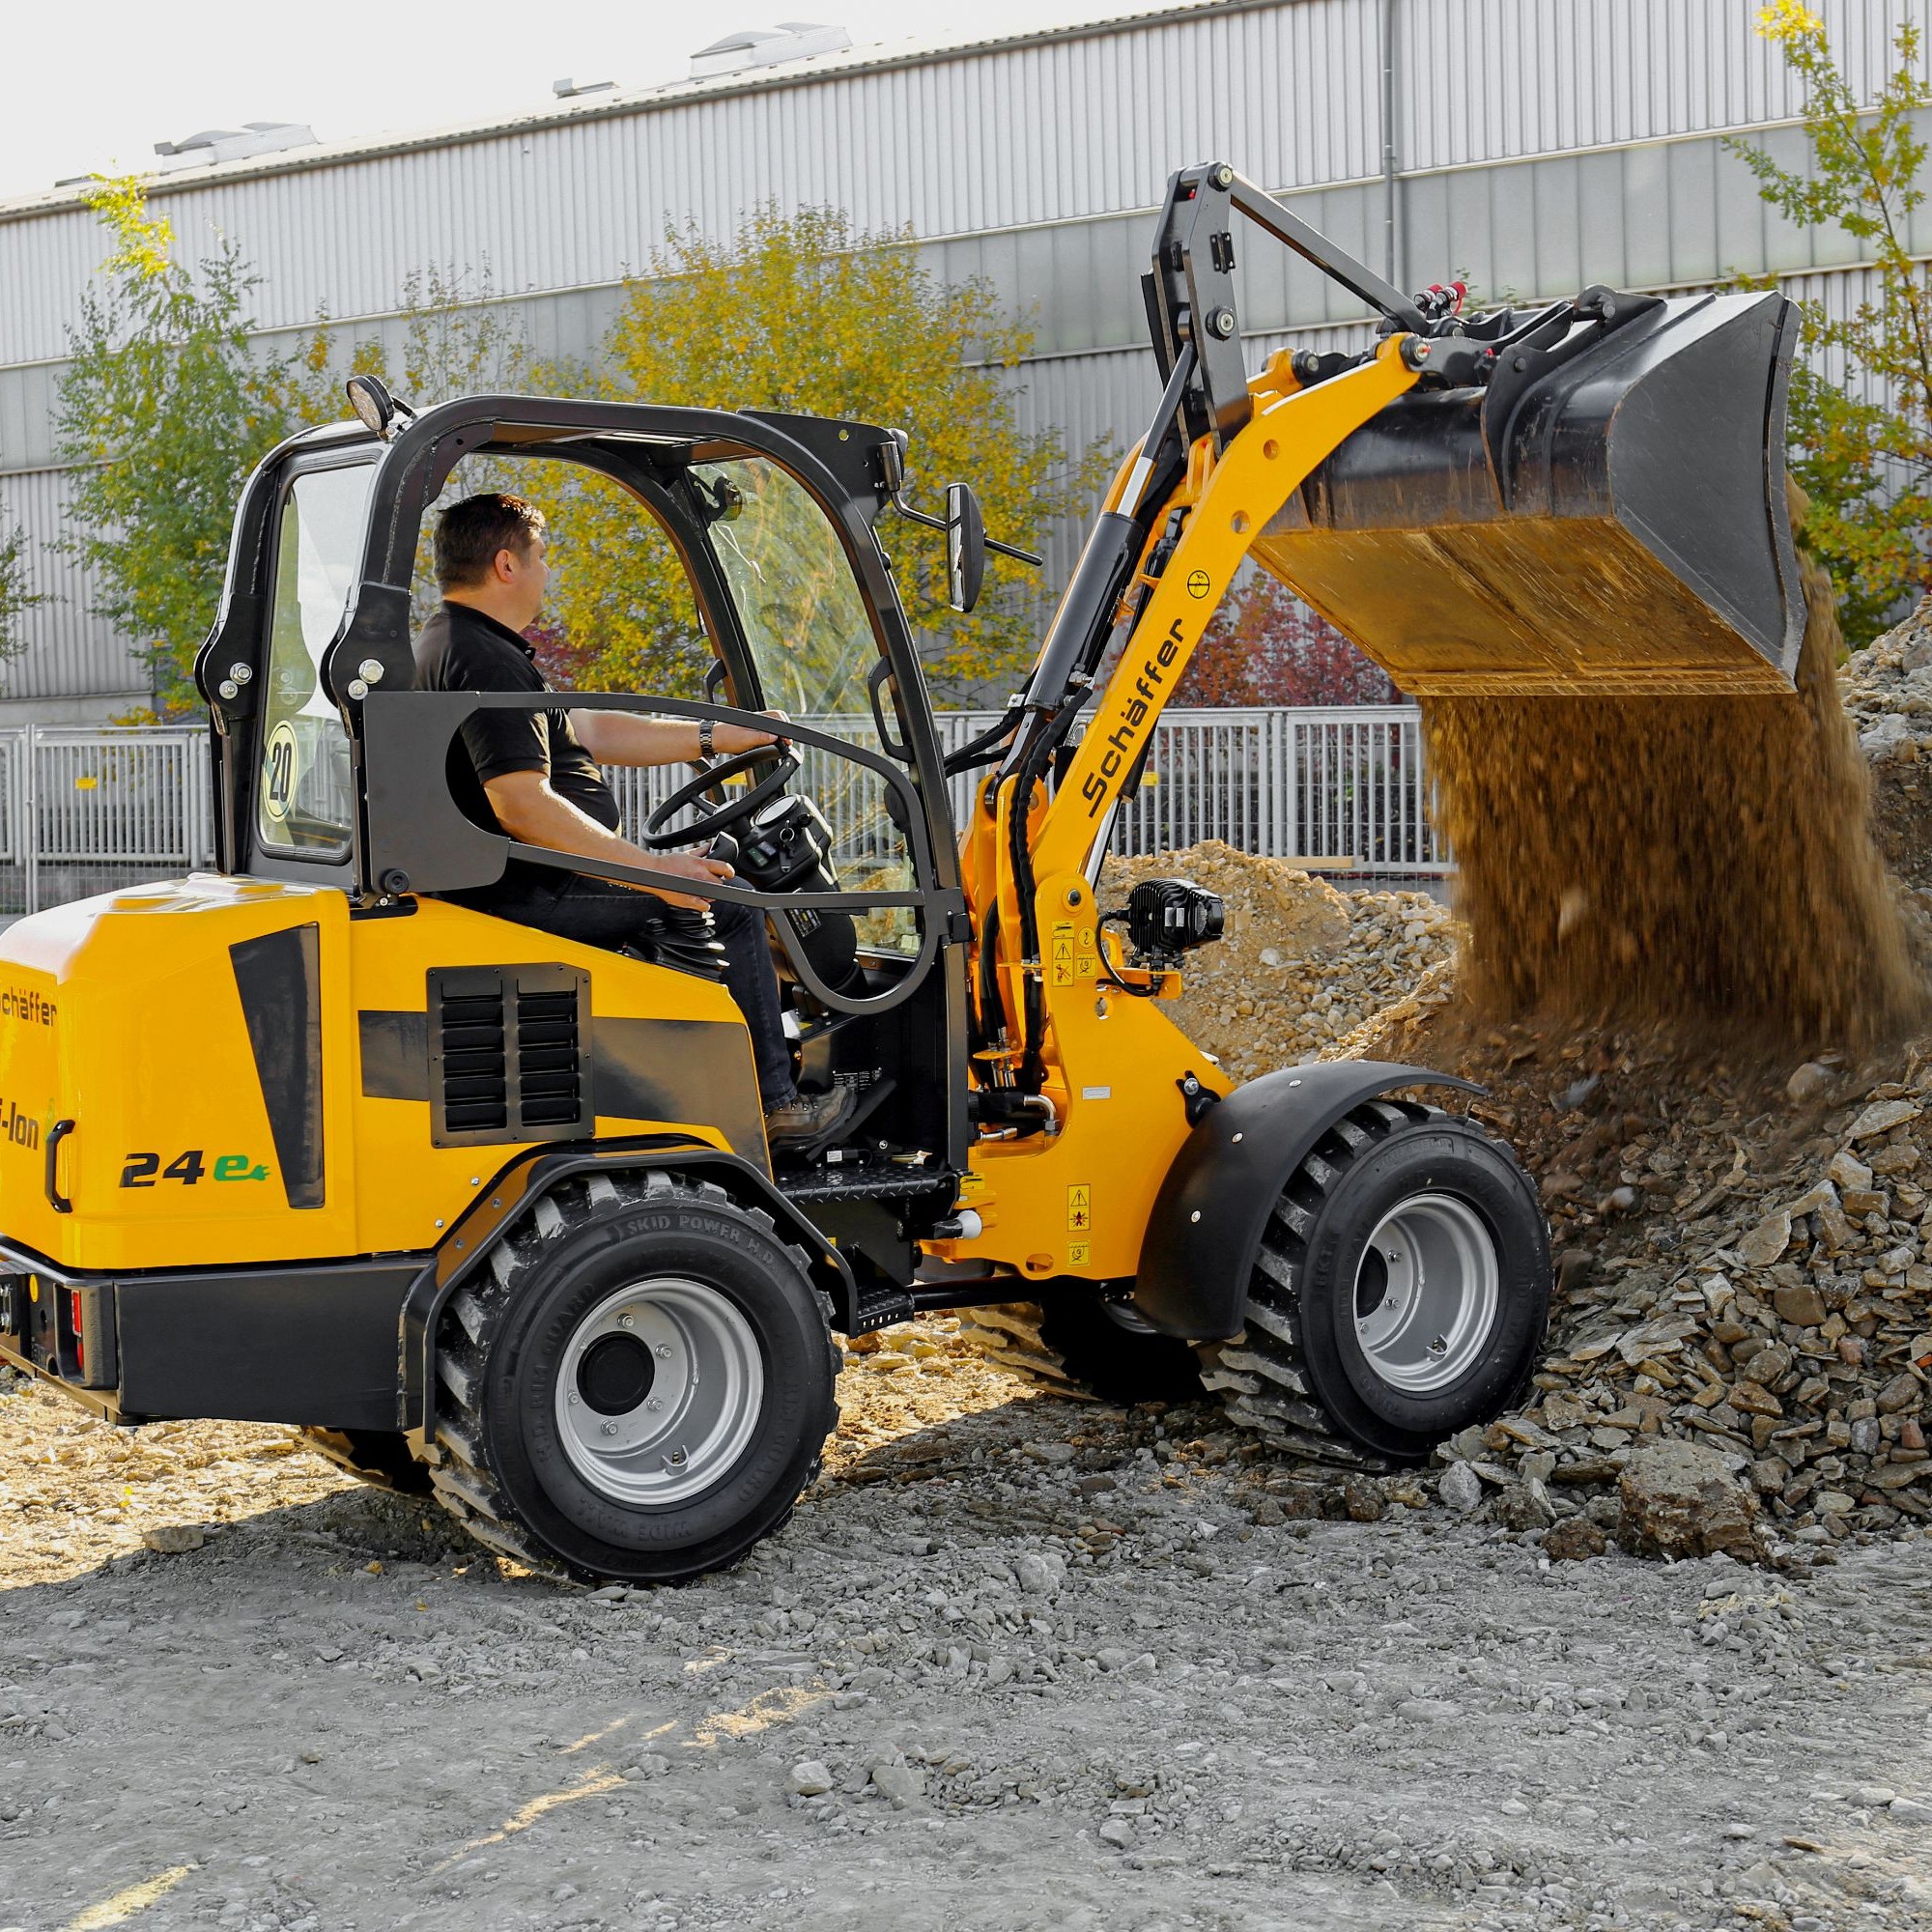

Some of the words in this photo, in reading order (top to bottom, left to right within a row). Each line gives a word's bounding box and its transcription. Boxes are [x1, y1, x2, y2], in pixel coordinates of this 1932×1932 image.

[1082, 618, 1184, 818] Schäffer
[270, 742, 292, 803] 20
[0, 986, 57, 1027] chäffer
[628, 1214, 671, 1236] SKID
[679, 1214, 742, 1243] POWER
